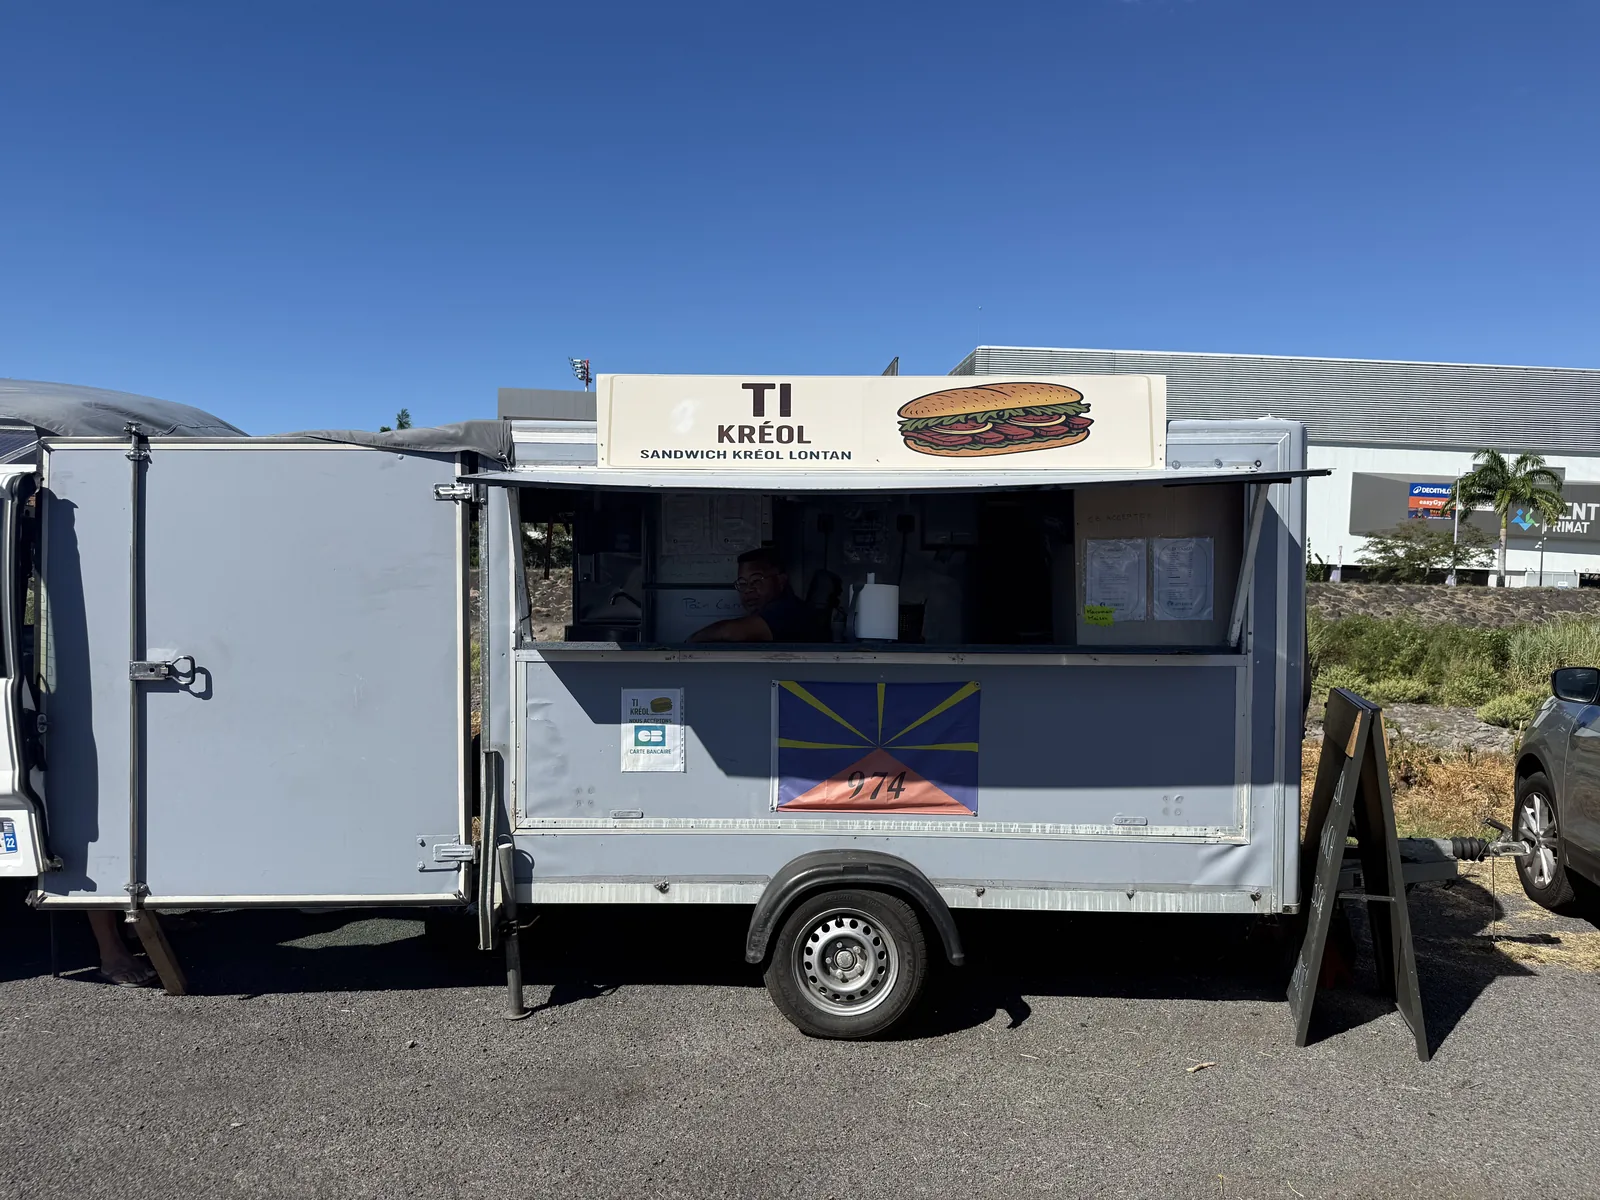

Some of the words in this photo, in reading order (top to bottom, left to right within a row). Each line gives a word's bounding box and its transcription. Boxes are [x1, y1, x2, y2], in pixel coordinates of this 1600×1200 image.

[741, 383, 792, 418] TI
[717, 421, 812, 444] KRÉOL
[640, 449, 727, 460] SANDWICH
[732, 448, 784, 460] KRÉOL
[789, 450, 852, 460] LONTAN
[631, 698, 639, 707] TI
[630, 707, 650, 716] KRÉOL
[847, 770, 907, 800] 974
[5, 837, 16, 848] 22
